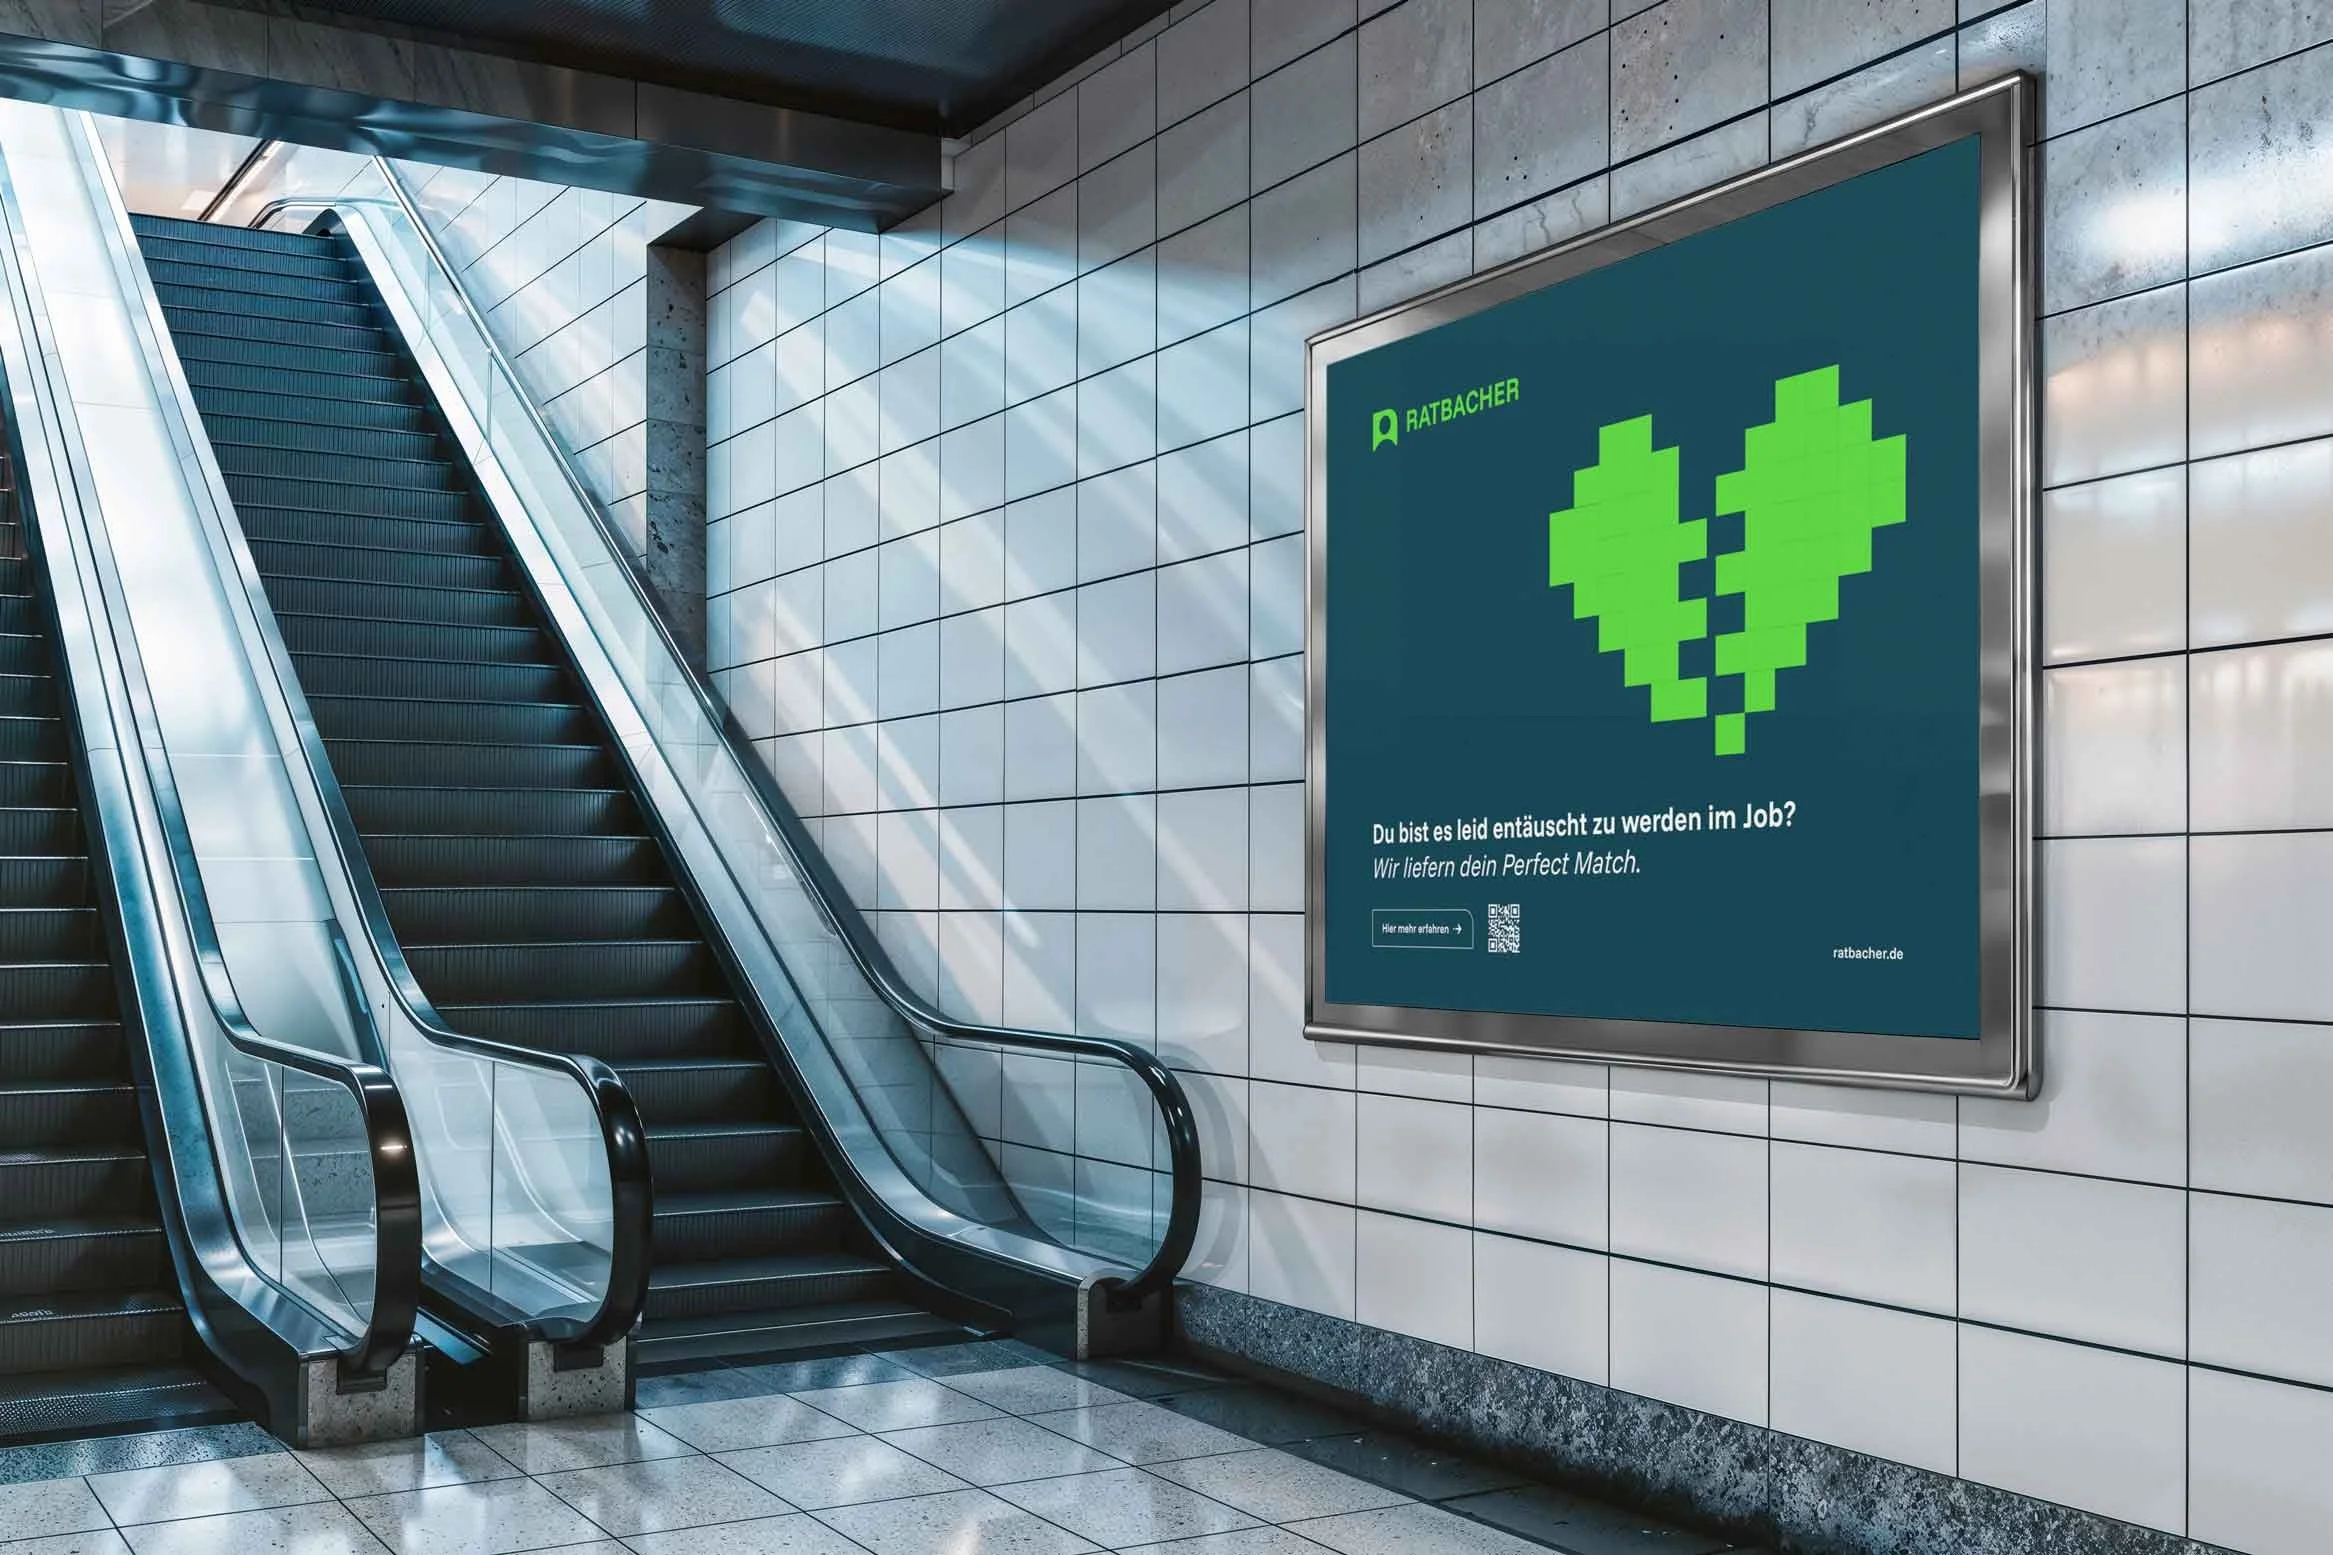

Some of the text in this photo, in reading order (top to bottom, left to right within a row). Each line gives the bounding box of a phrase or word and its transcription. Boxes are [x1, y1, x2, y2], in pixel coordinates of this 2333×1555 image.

[1407, 378, 1519, 432] RATBACHER
[1374, 801, 1796, 844] Du bist es leid entäuscht zu werden im Job?
[1375, 849, 1640, 878] Wir liefern dein Perfect Match.
[1382, 924, 1449, 934] Hier mehr erfahren
[1834, 947, 1903, 959] ratbacher.de
